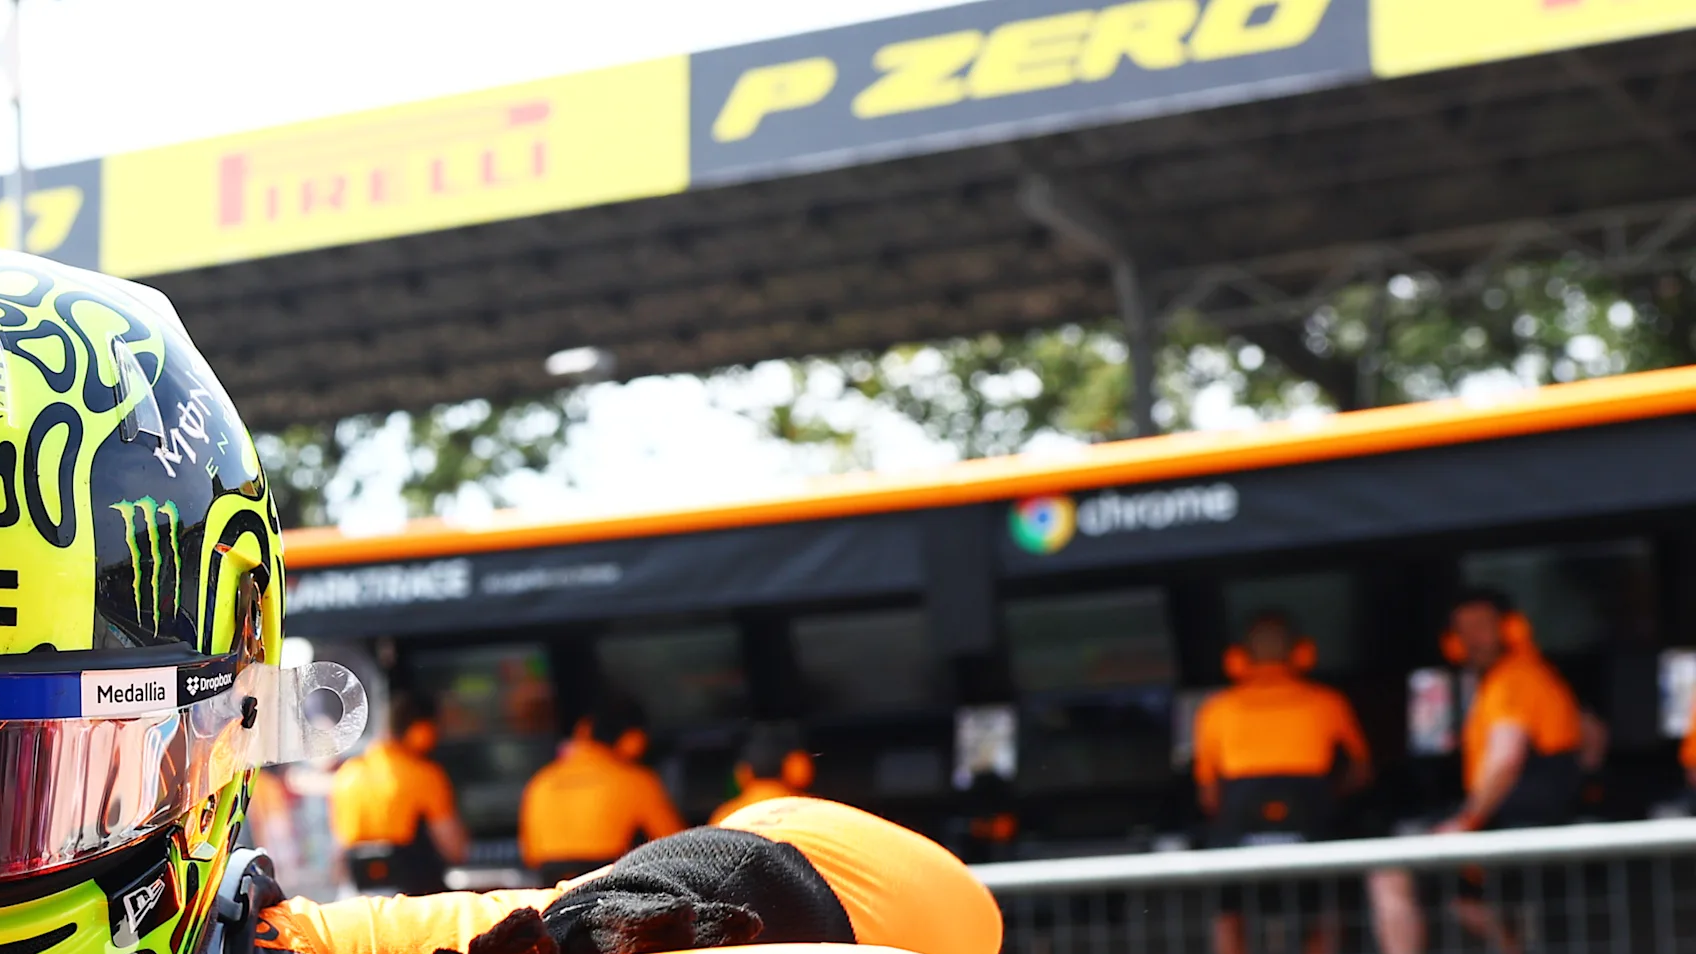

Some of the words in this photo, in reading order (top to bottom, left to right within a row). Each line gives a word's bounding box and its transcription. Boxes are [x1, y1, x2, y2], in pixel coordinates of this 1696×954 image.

[711, 56, 838, 143] P
[851, 0, 1328, 118] ZERO
[1078, 482, 1239, 536] chrome
[97, 681, 166, 704] Medallia
[200, 672, 233, 692] Dropbox
